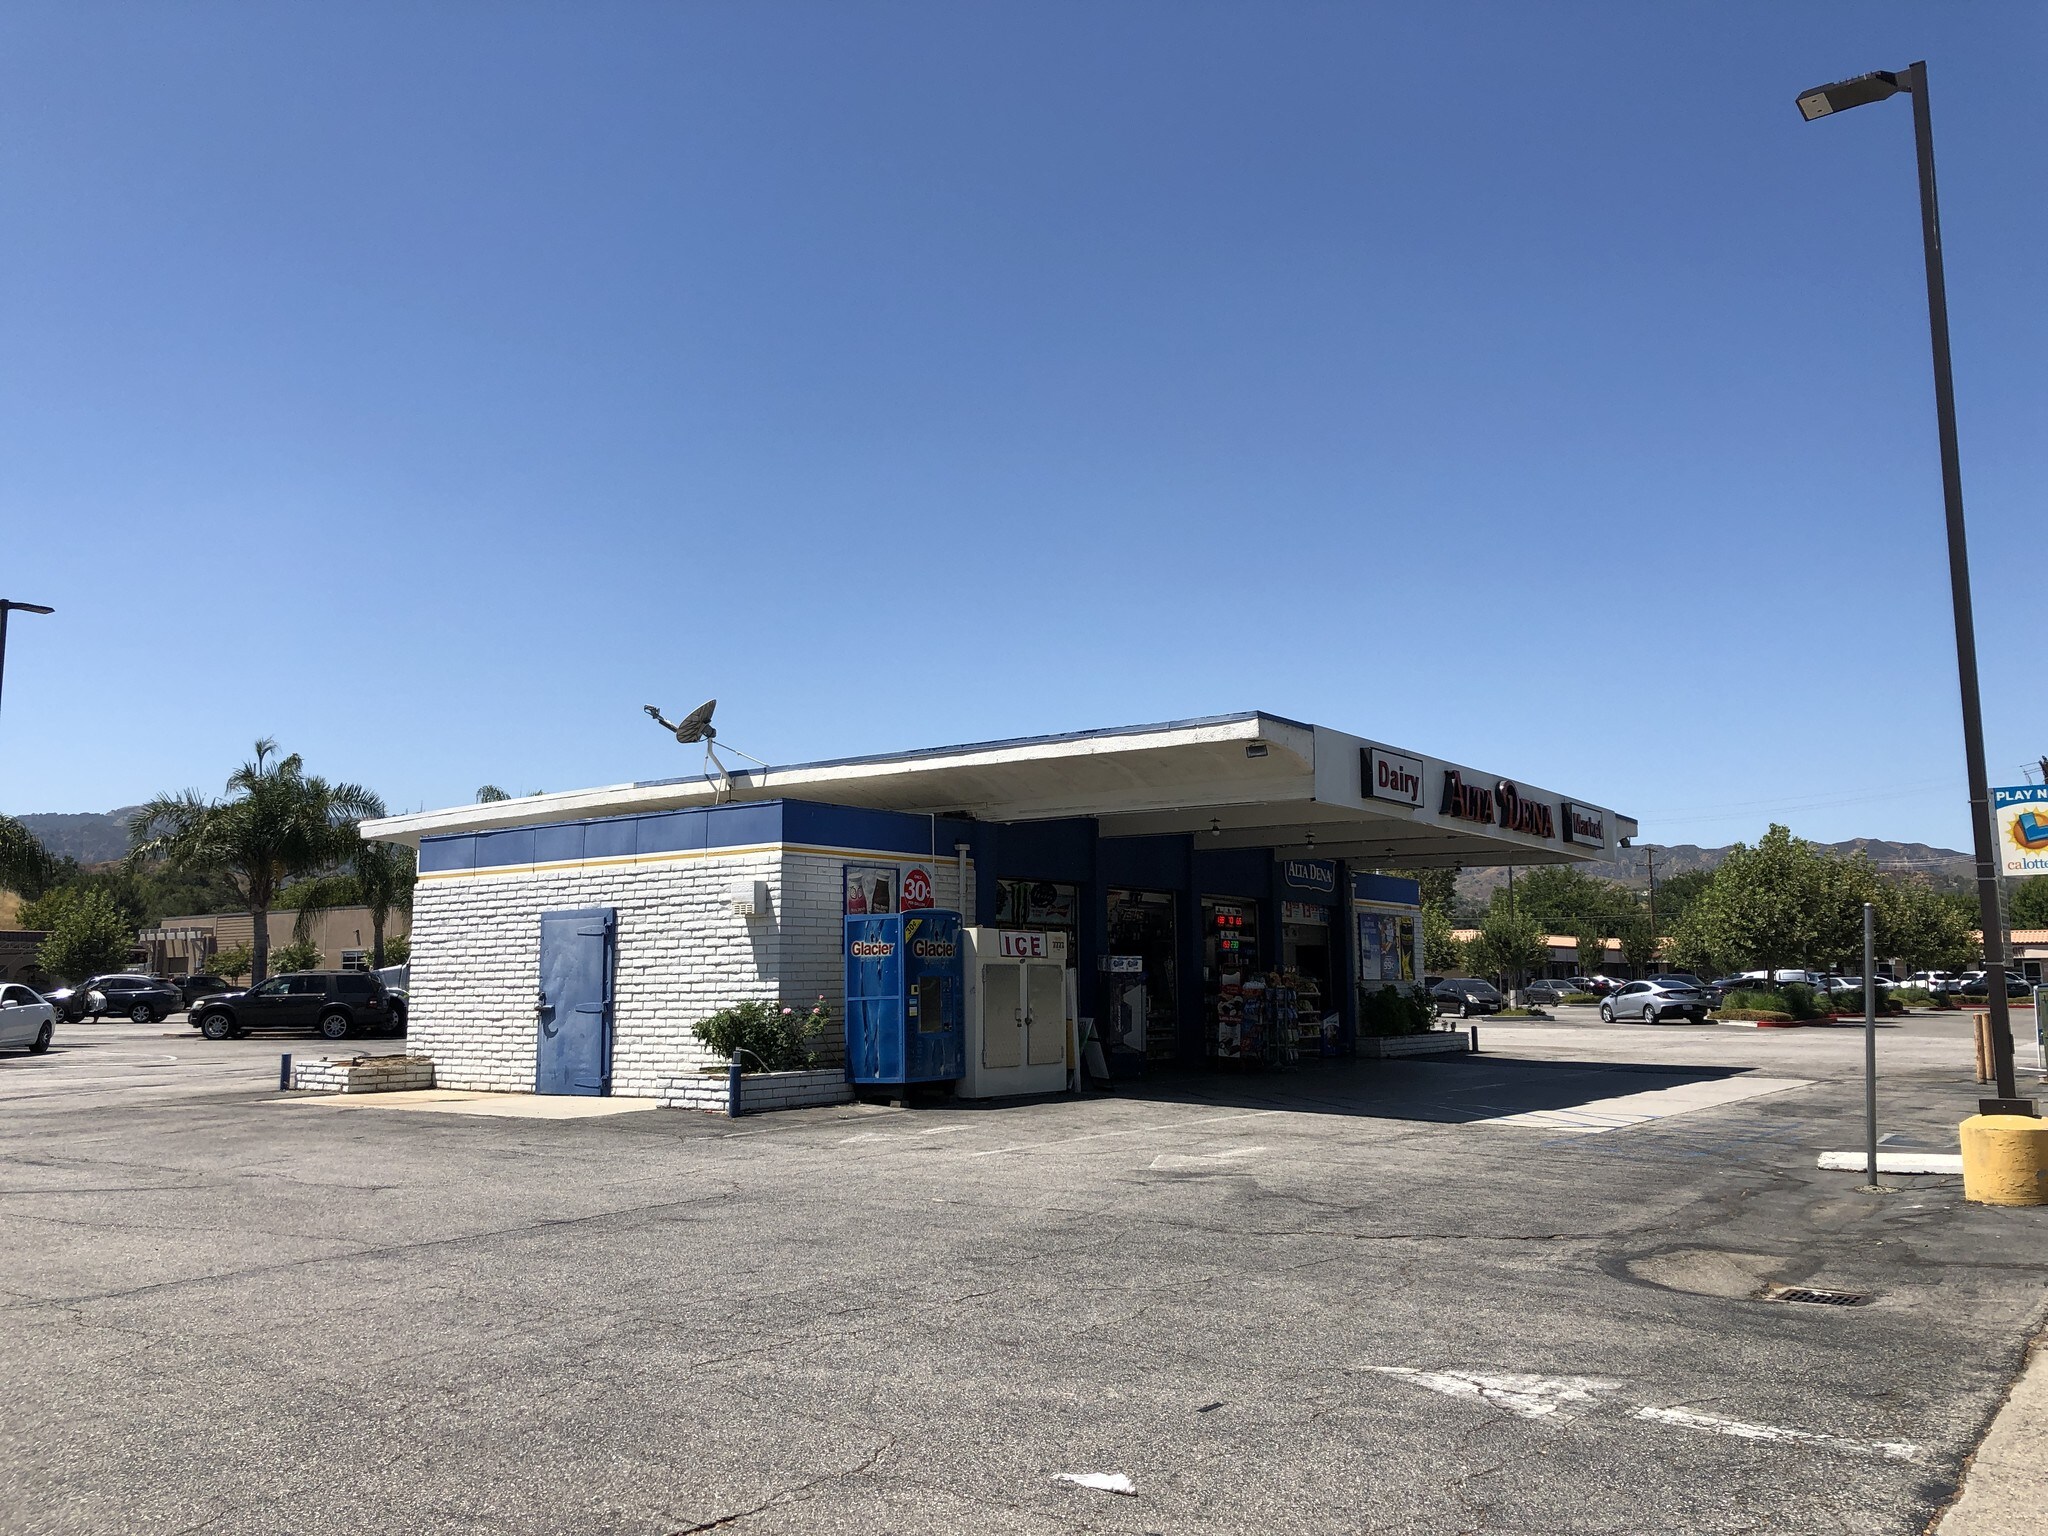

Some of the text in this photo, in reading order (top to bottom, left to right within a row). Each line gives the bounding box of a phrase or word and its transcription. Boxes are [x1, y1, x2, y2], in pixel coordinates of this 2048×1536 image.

[1378, 760, 1419, 801] Dairy
[1996, 789, 2033, 801] PLAY
[1573, 812, 1603, 839] Market
[852, 940, 894, 956] Glacier
[913, 939, 957, 957] Glacier
[1005, 936, 1041, 956] ICE
